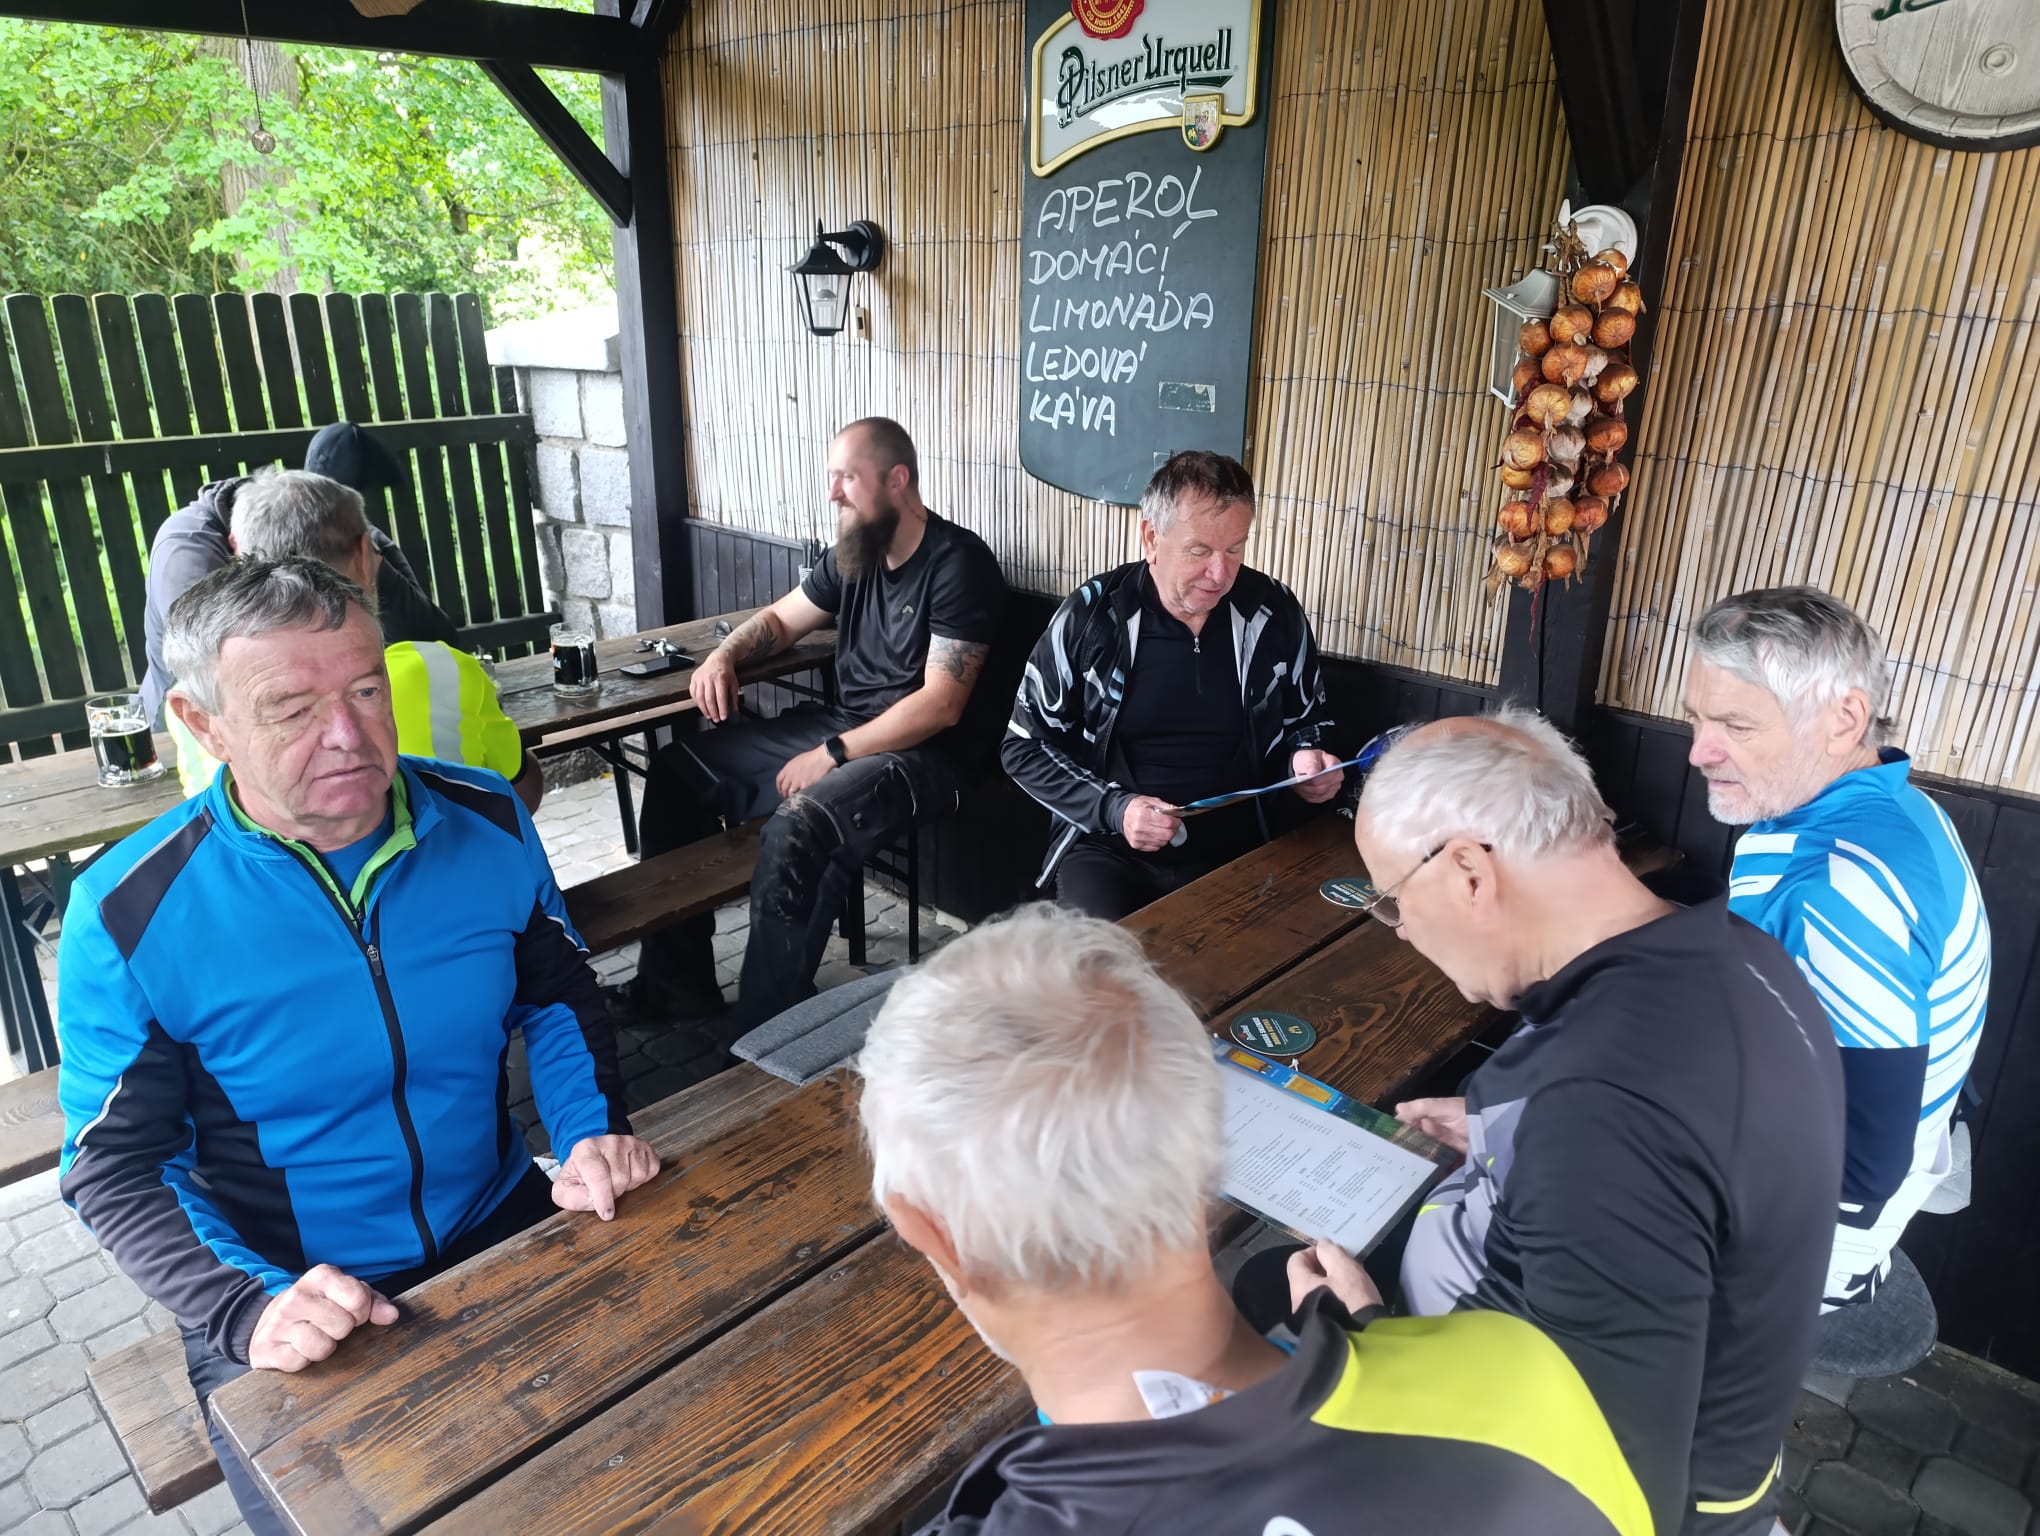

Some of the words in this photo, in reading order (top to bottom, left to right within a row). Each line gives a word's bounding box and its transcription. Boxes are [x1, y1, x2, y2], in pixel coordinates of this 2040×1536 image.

[1094, 17, 1112, 27] ROKU
[1113, 3, 1128, 23] 1842
[1056, 46, 1143, 129] Pilsner
[1142, 28, 1232, 99] Urquell
[1036, 165, 1219, 239] APEROL
[1028, 274, 1215, 333] LIMONÁDA
[1025, 340, 1148, 384] LEDOVÁ
[1029, 386, 1116, 437] KÁVA
